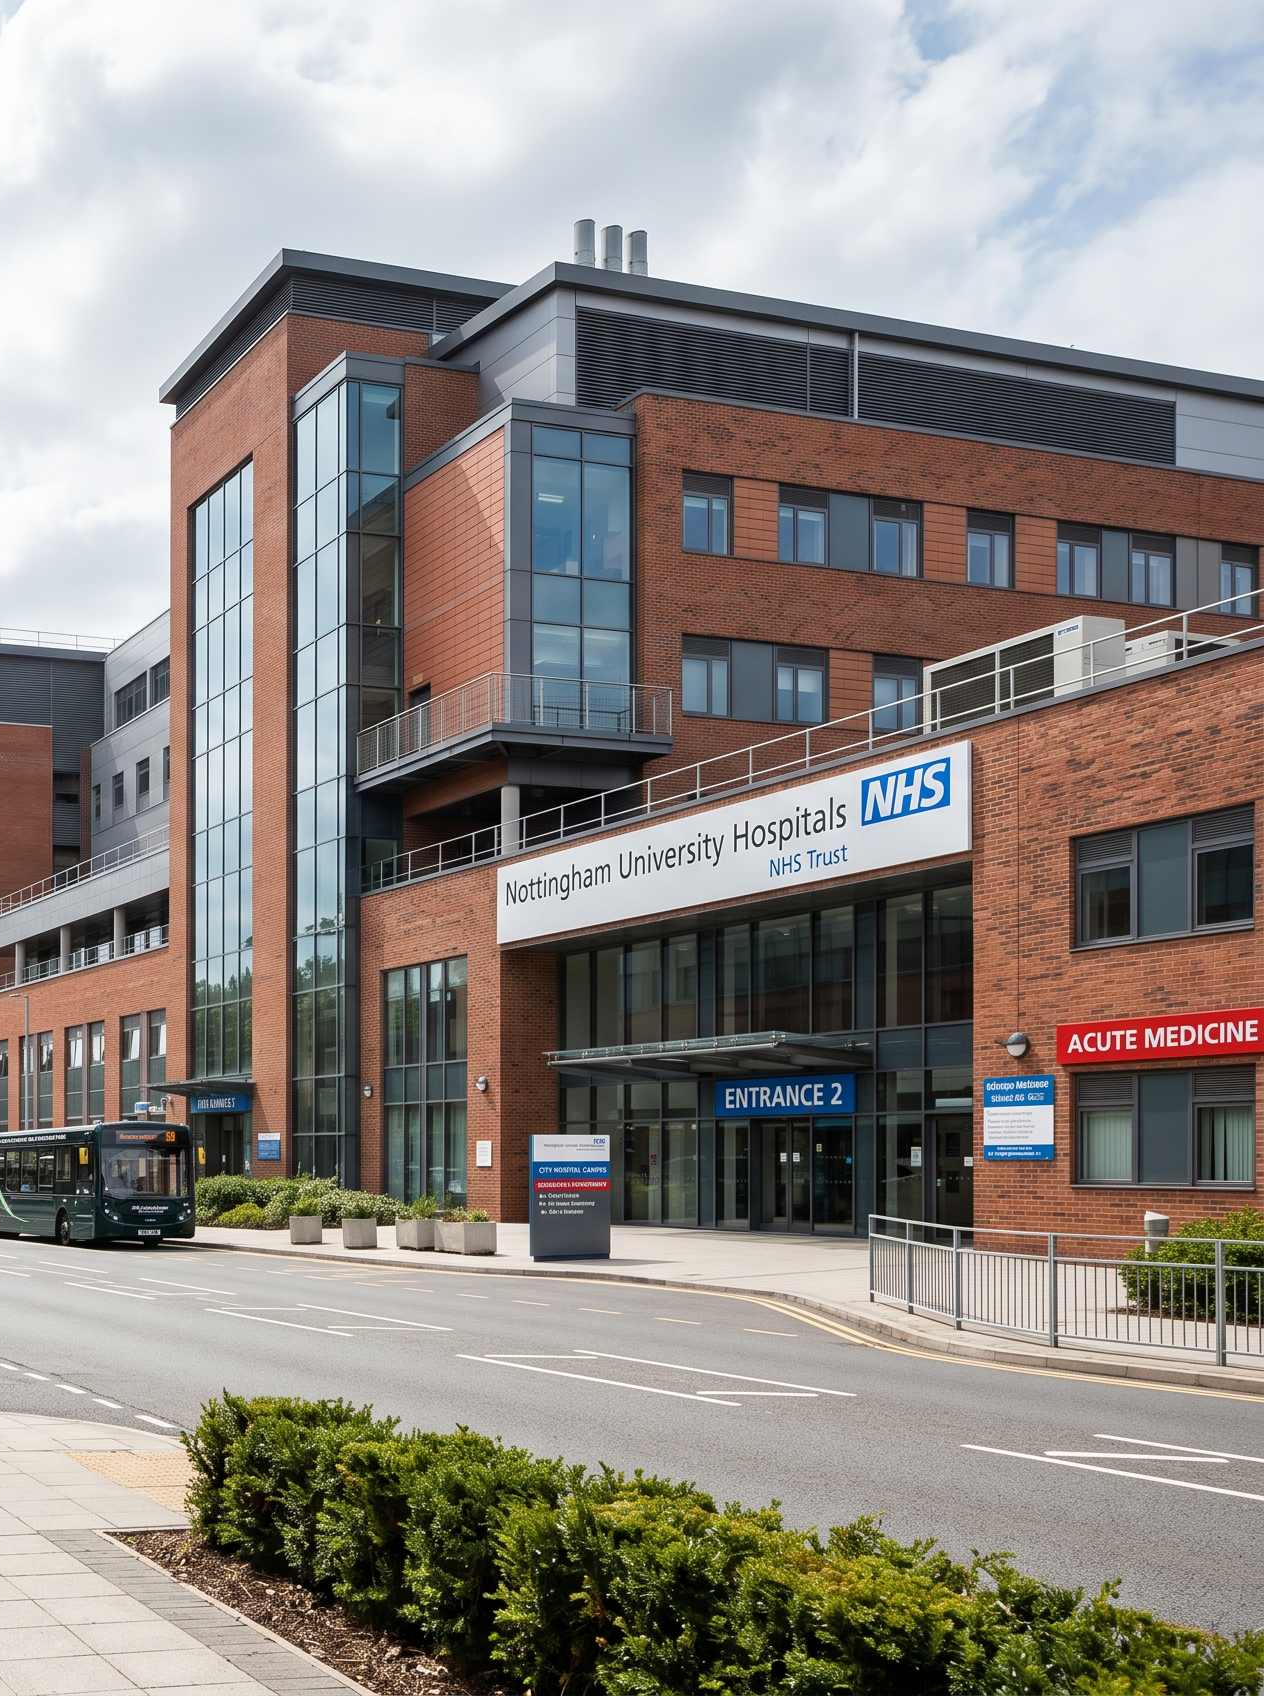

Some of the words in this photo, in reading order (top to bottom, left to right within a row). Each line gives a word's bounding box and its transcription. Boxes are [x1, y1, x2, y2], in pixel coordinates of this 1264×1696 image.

[864, 762, 947, 822] NHS
[505, 863, 611, 906] Nottingham
[619, 833, 725, 880] University
[733, 797, 847, 853] Hospitals
[769, 853, 802, 878] NHS
[806, 844, 848, 869] Trust
[1067, 1029, 1138, 1054] ACUTE
[1144, 1020, 1259, 1049] MEDICINE
[725, 1083, 824, 1109] ENTRANCE
[830, 1082, 843, 1105] 2
